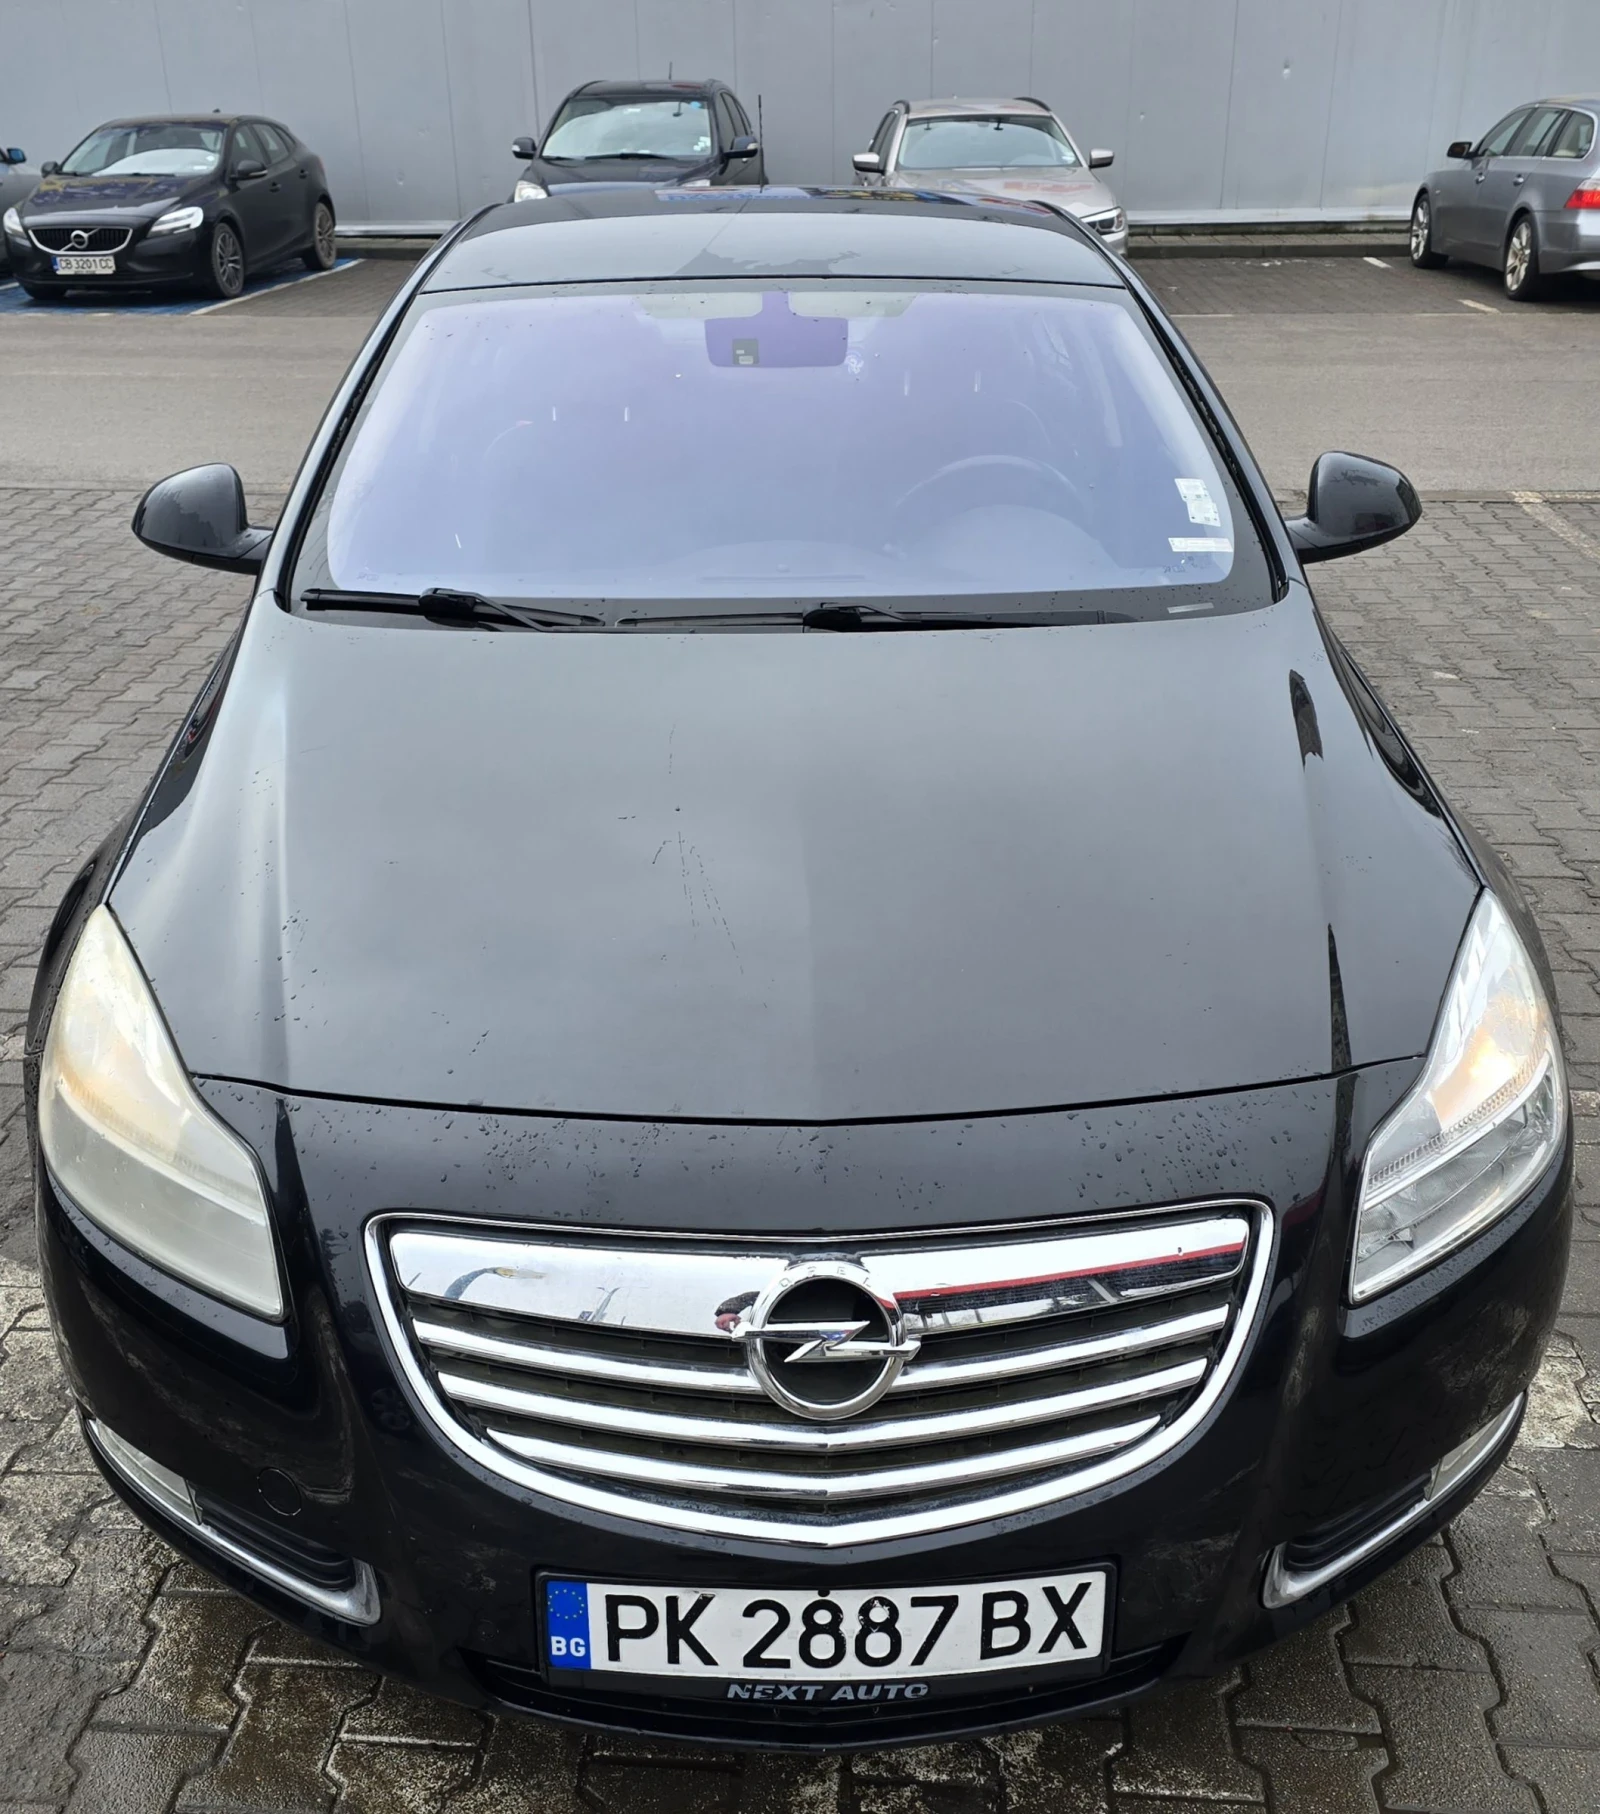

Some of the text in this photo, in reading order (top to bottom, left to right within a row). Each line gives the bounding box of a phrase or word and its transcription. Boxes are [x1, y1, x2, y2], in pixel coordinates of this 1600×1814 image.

[74, 258, 98, 270] 3201
[99, 258, 114, 270] CC
[779, 1266, 872, 1288] OPEL
[605, 1581, 1092, 1669] PK 2887 BX
[551, 1636, 586, 1657] BG
[727, 1683, 929, 1700] NEXT AUTO
